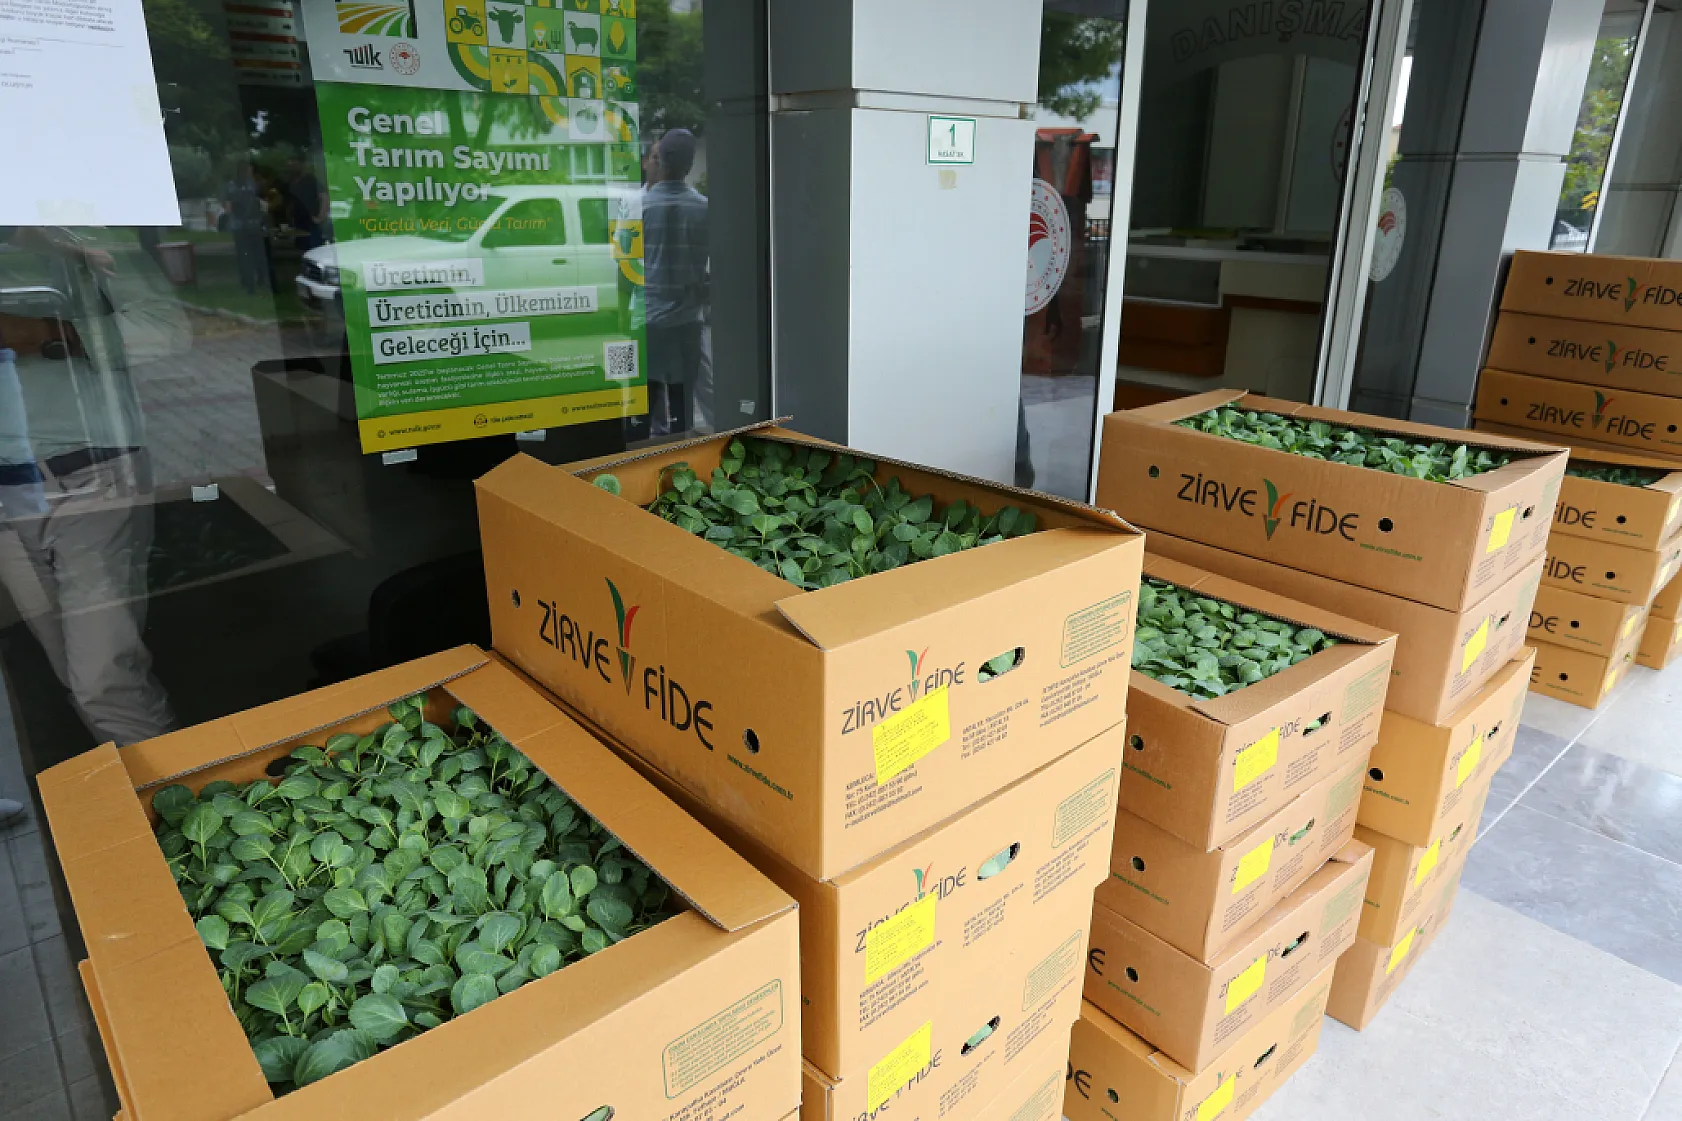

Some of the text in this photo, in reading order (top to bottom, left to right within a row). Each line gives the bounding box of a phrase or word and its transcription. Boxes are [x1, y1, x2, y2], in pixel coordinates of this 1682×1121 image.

[347, 107, 444, 137] Genel
[949, 124, 956, 147] 1
[350, 139, 550, 177] Tarım Sayımı
[353, 176, 492, 207] Yapılıyor
[372, 263, 477, 287] Üretimin,
[1563, 278, 1622, 300] ZİRVE
[375, 293, 591, 322] Üreticinin, Ülkemizin
[380, 327, 527, 356] Geleceği İçin...
[1546, 339, 1669, 372] ZİRVE FİDE
[1526, 402, 1657, 440] ZİRVE FİDE
[1177, 473, 1360, 542] ZİRVE FİDE
[538, 599, 714, 752] ZİRVE FİDE
[842, 687, 903, 736] ZİRVE
